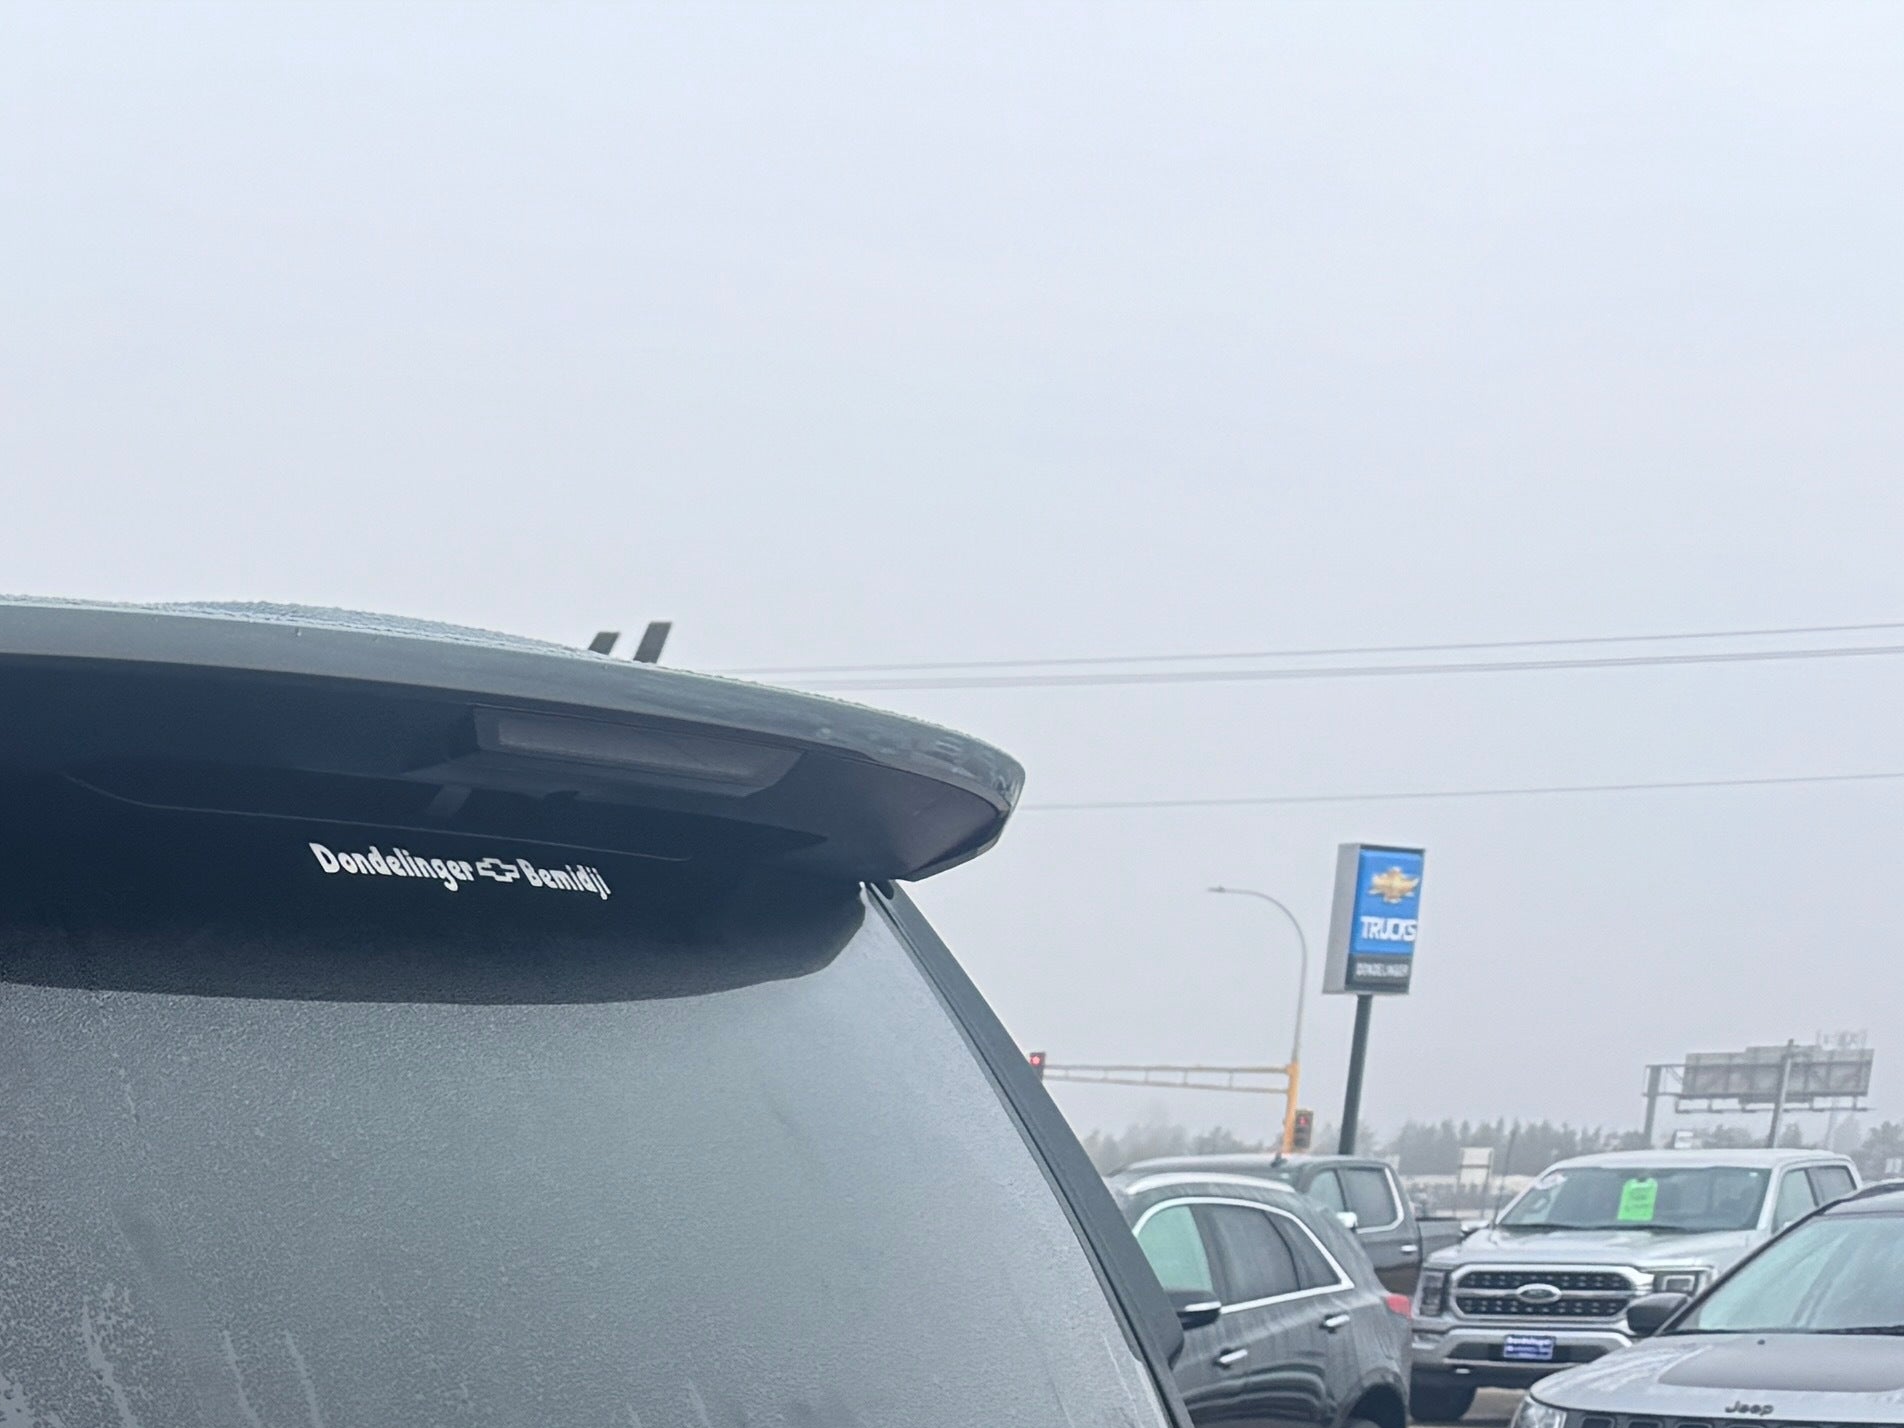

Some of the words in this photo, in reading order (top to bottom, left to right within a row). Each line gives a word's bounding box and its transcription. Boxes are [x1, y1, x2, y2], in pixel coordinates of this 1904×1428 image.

[308, 842, 475, 891] Dondelinger
[515, 858, 611, 900] Bemidji
[1359, 915, 1418, 942] TRUCKS
[1725, 1400, 1774, 1417] Jeep
